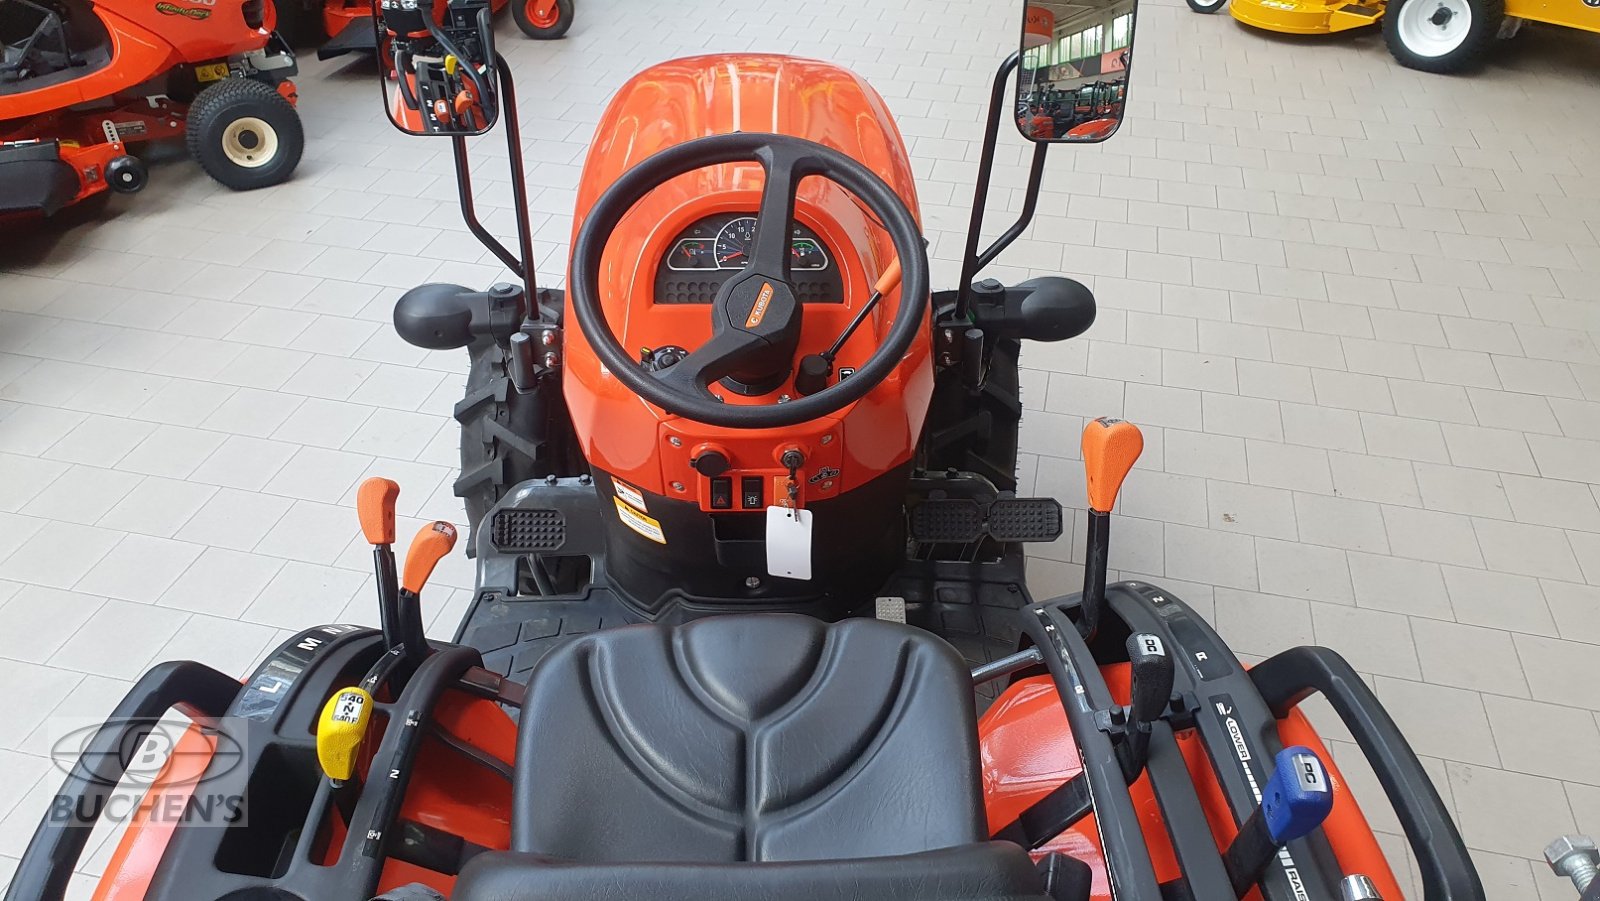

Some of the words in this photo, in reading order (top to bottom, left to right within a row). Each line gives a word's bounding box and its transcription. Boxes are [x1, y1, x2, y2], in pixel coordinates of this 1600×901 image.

[754, 289, 771, 316] KUBOTA
[296, 636, 323, 651] M
[1144, 638, 1158, 653] DC
[258, 681, 283, 695] L
[339, 693, 365, 705] 540
[342, 704, 355, 714] N
[1227, 720, 1248, 759] LOWER
[389, 768, 400, 779] N
